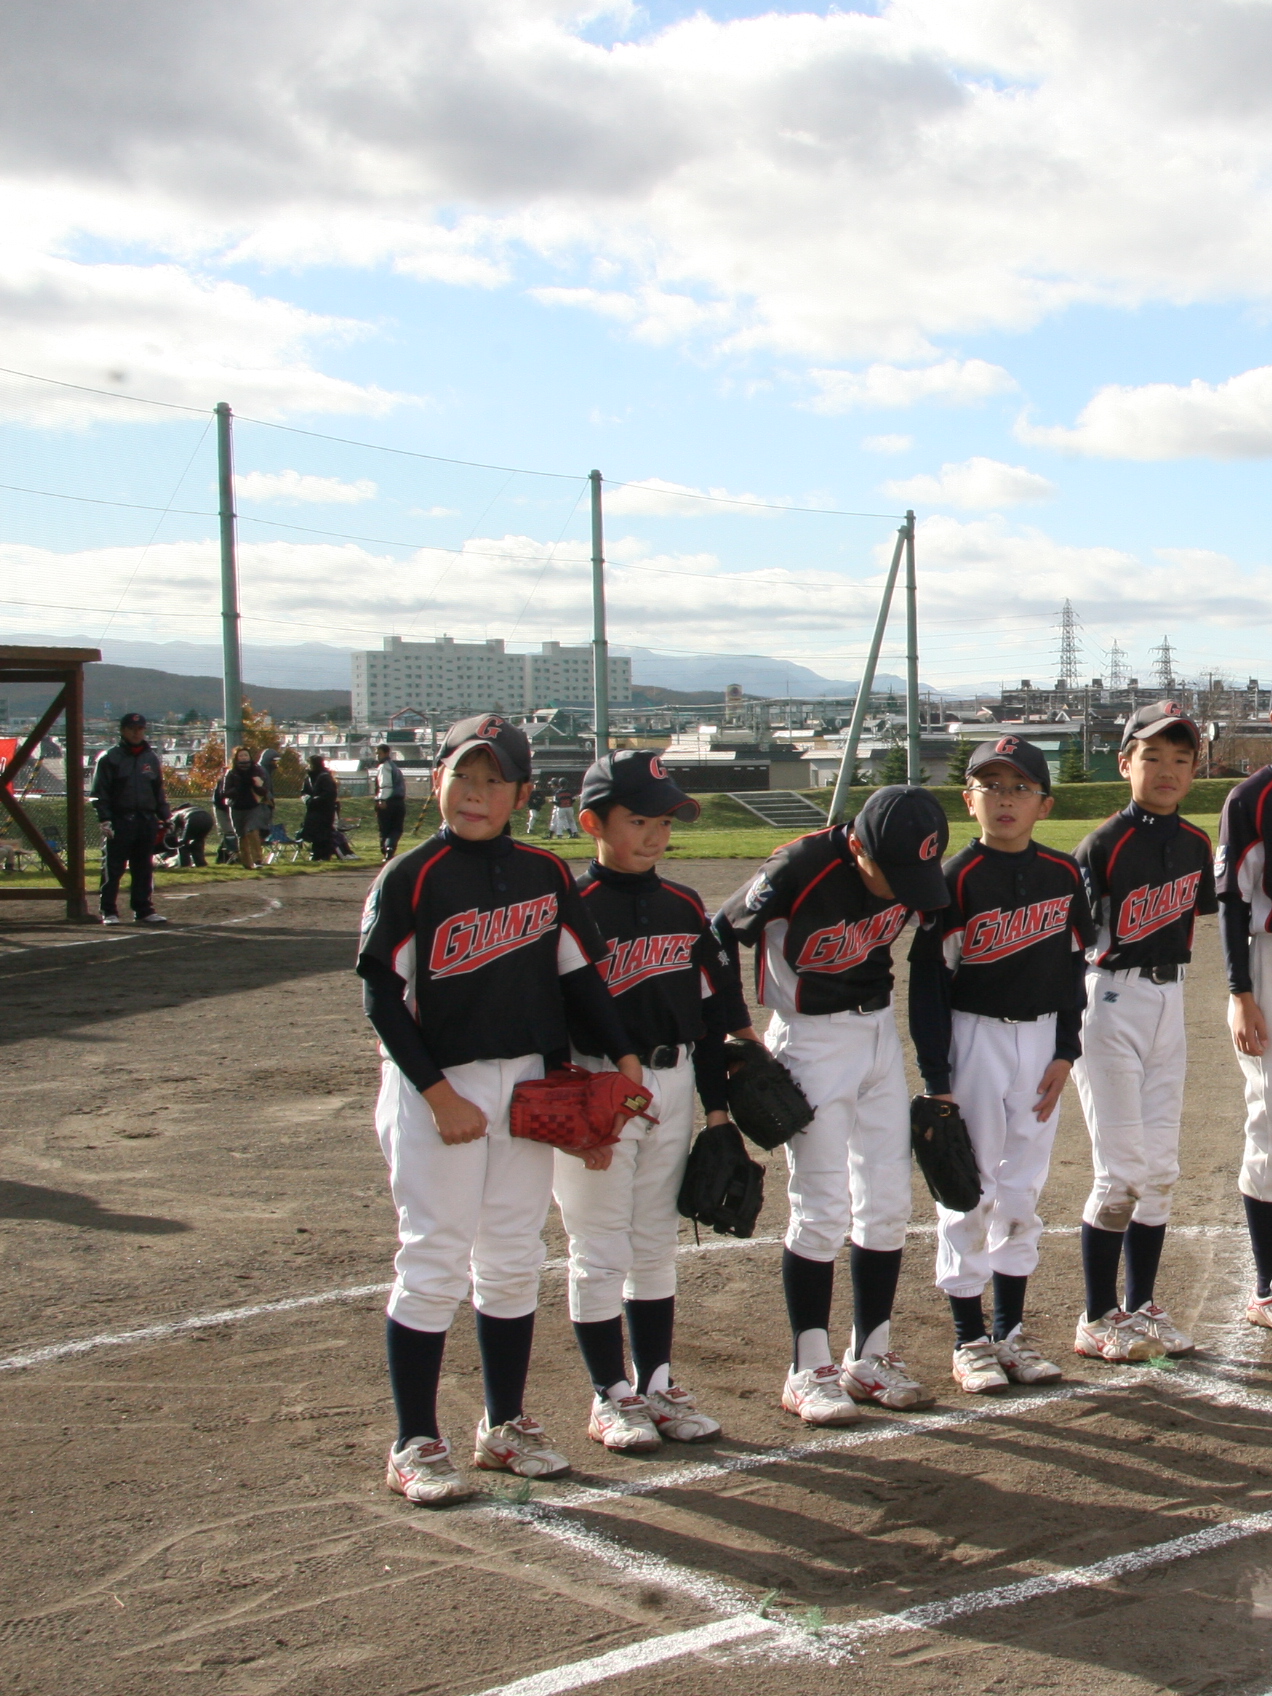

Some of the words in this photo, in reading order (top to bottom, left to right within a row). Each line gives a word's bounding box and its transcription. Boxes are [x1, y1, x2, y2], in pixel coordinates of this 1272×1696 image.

[1163, 701, 1183, 717] G
[476, 714, 504, 739] G
[995, 736, 1021, 754] G
[650, 755, 668, 779] G
[919, 830, 939, 860] G
[1116, 870, 1202, 938] GIANT
[429, 892, 558, 973] GIANTS
[961, 894, 1074, 959] GIANTS
